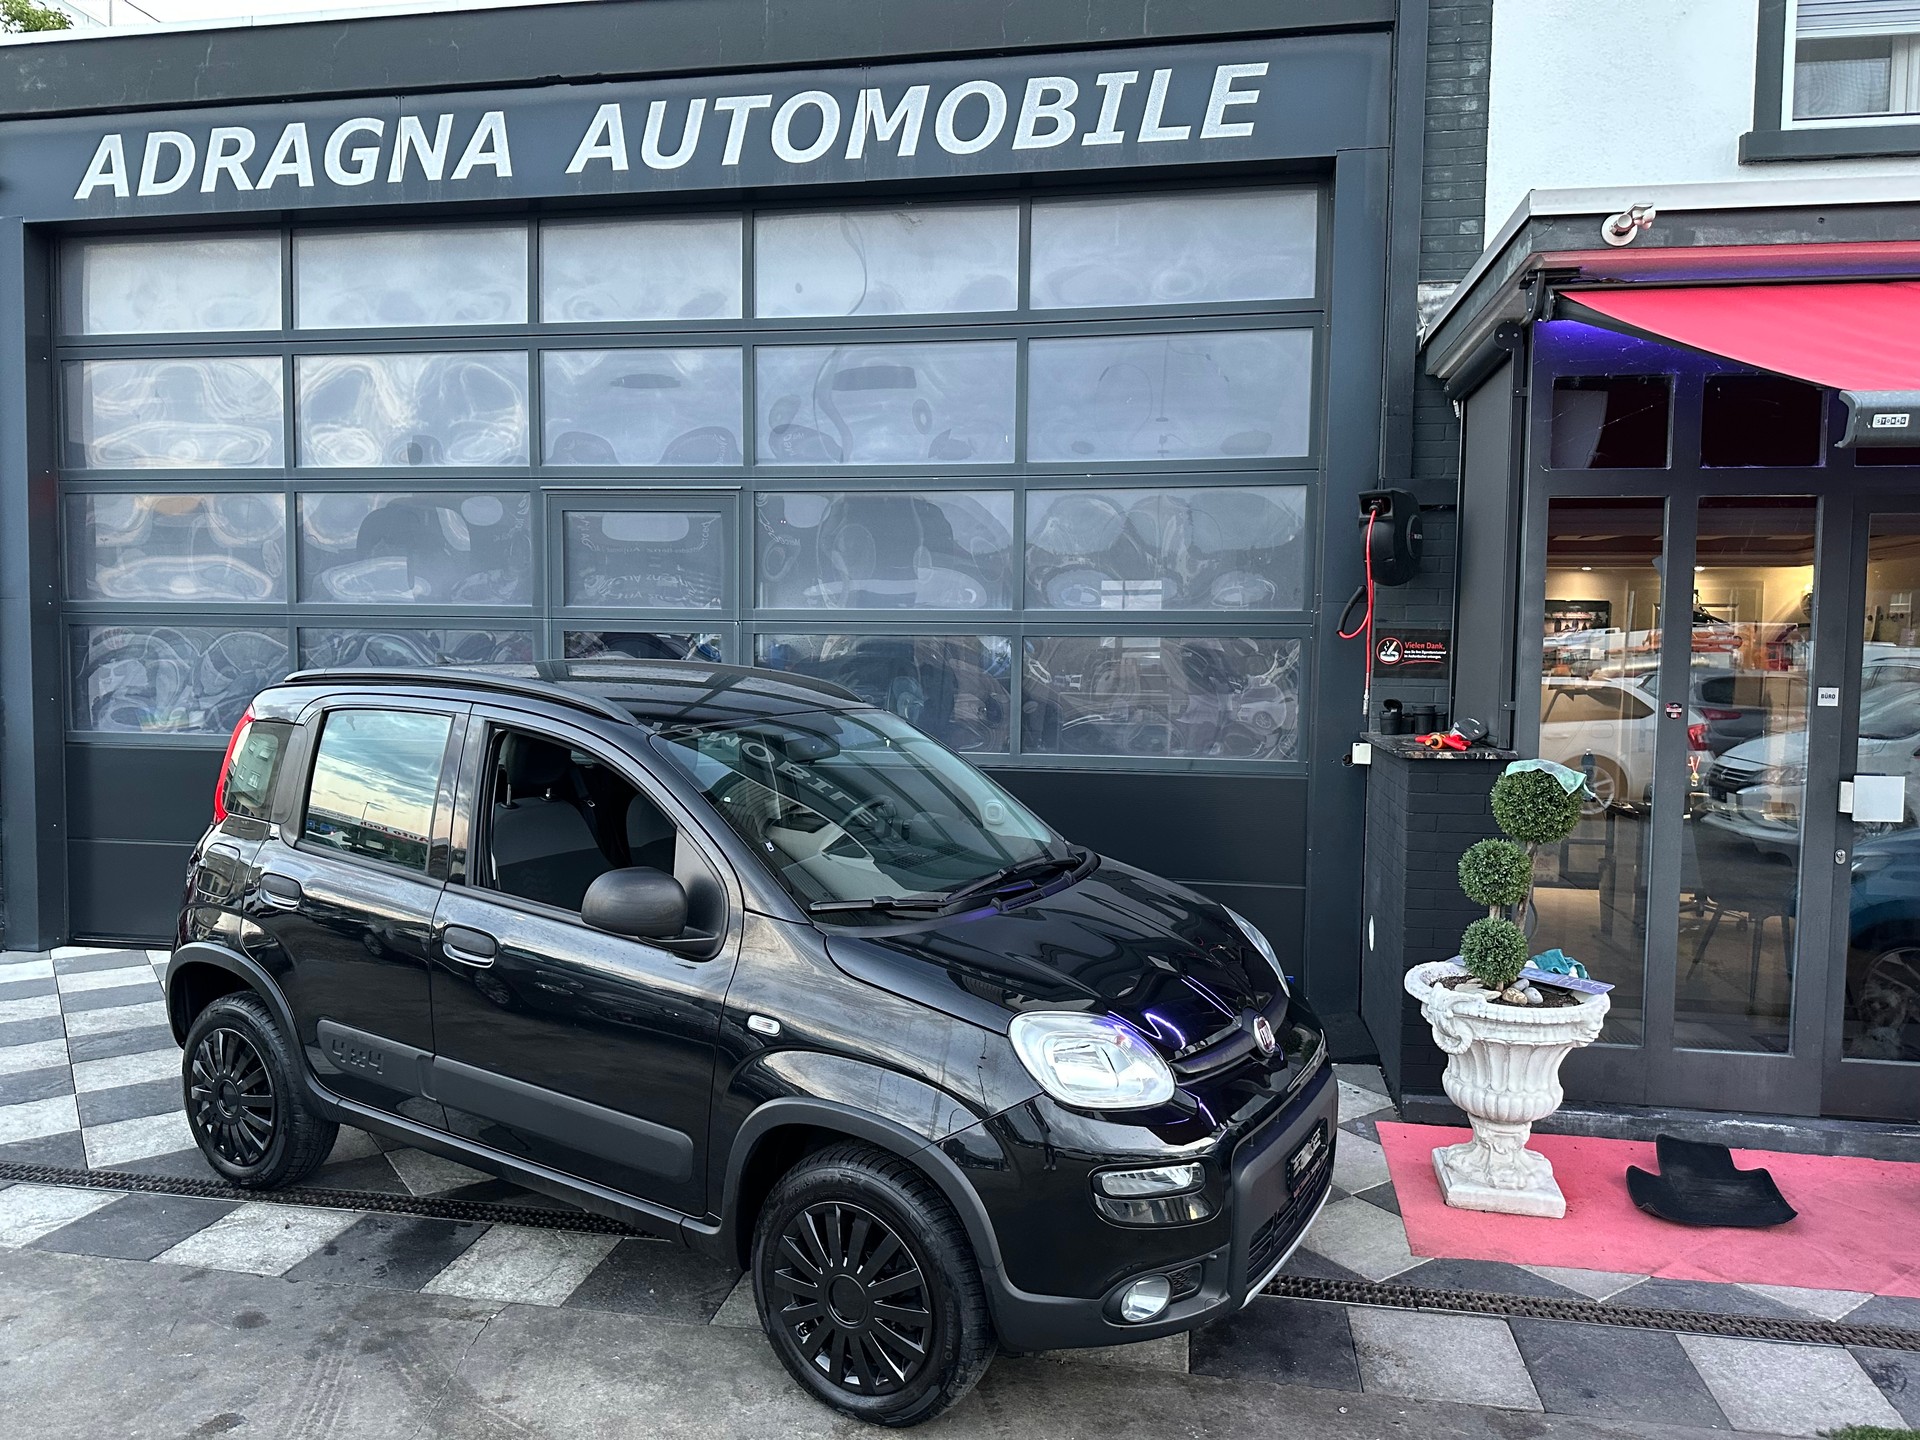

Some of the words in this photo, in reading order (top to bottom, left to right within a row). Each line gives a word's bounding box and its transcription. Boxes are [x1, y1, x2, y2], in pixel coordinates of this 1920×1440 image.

[74, 110, 513, 200] ADRAGNA
[565, 62, 1270, 174] AUTOMOBILE
[1405, 641, 1425, 649] Vielen
